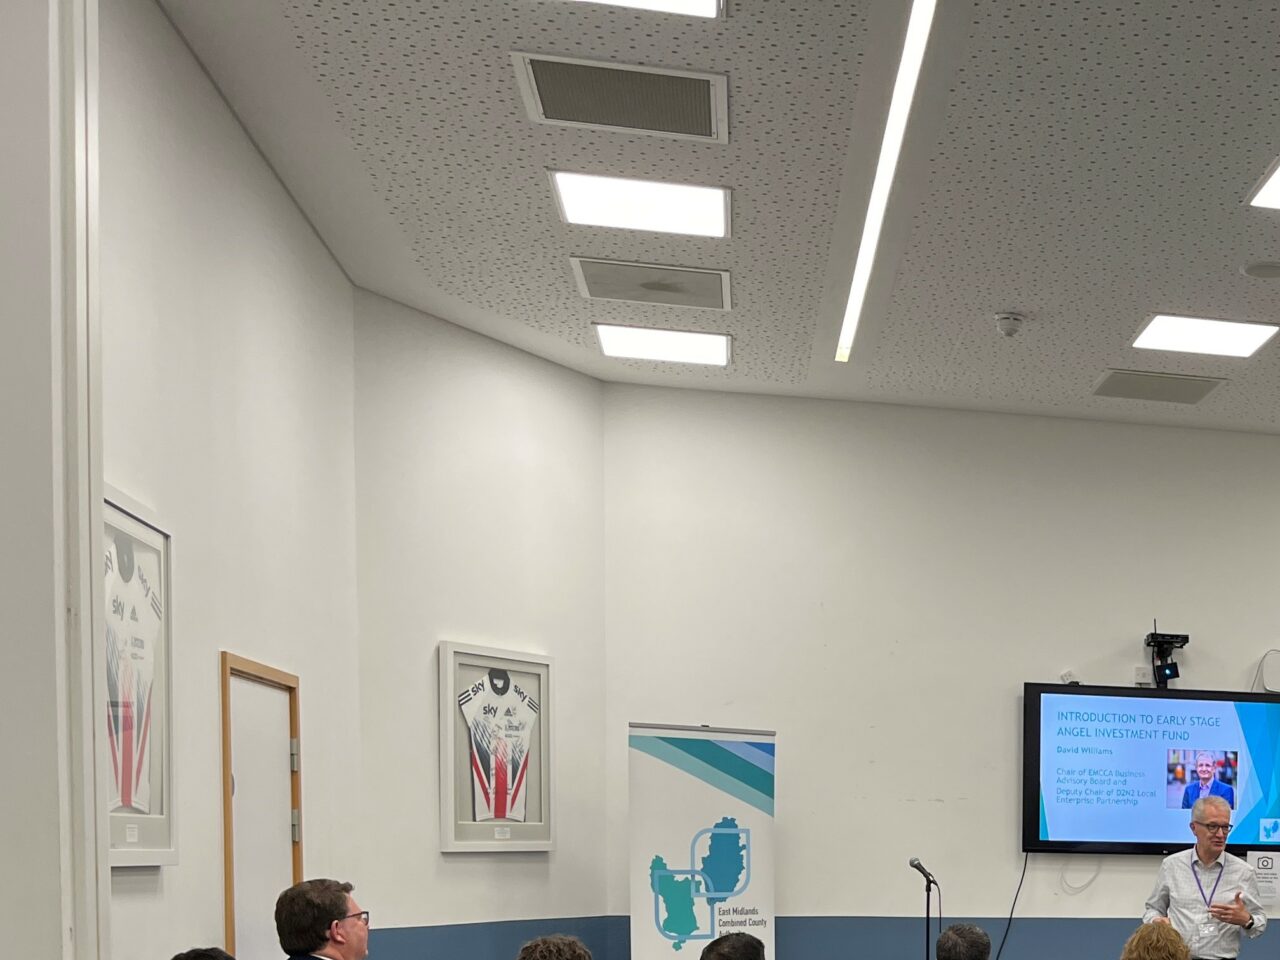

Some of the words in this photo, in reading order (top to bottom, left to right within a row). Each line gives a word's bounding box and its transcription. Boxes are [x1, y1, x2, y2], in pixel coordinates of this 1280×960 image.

[112, 594, 124, 621] sky
[471, 680, 485, 696] sky
[514, 684, 528, 702] sky
[483, 704, 498, 718] sky
[1057, 712, 1136, 723] INTRODUCTION
[1140, 714, 1154, 724] TO
[1157, 715, 1186, 726] EARLY
[1190, 716, 1220, 726] STAGE
[1057, 727, 1092, 738] ANGEL
[1095, 728, 1159, 740] INVESTMENT
[1162, 730, 1190, 740] FUND
[1056, 746, 1079, 754] David
[1080, 747, 1113, 755] Williams
[1056, 768, 1076, 776] Chair
[1056, 778, 1087, 786] Advisory
[1090, 778, 1111, 786] Board
[1113, 778, 1126, 786] and
[1056, 788, 1082, 797] Deputy
[1085, 788, 1104, 796] Chair
[1107, 788, 1114, 796] of
[1116, 789, 1135, 797] D2N2
[1056, 796, 1094, 806] Enterprise
[1096, 797, 1138, 807] Partnership
[718, 908, 730, 916] East
[732, 907, 758, 915] Midlands
[718, 918, 747, 927] Combined
[748, 918, 767, 928] County
